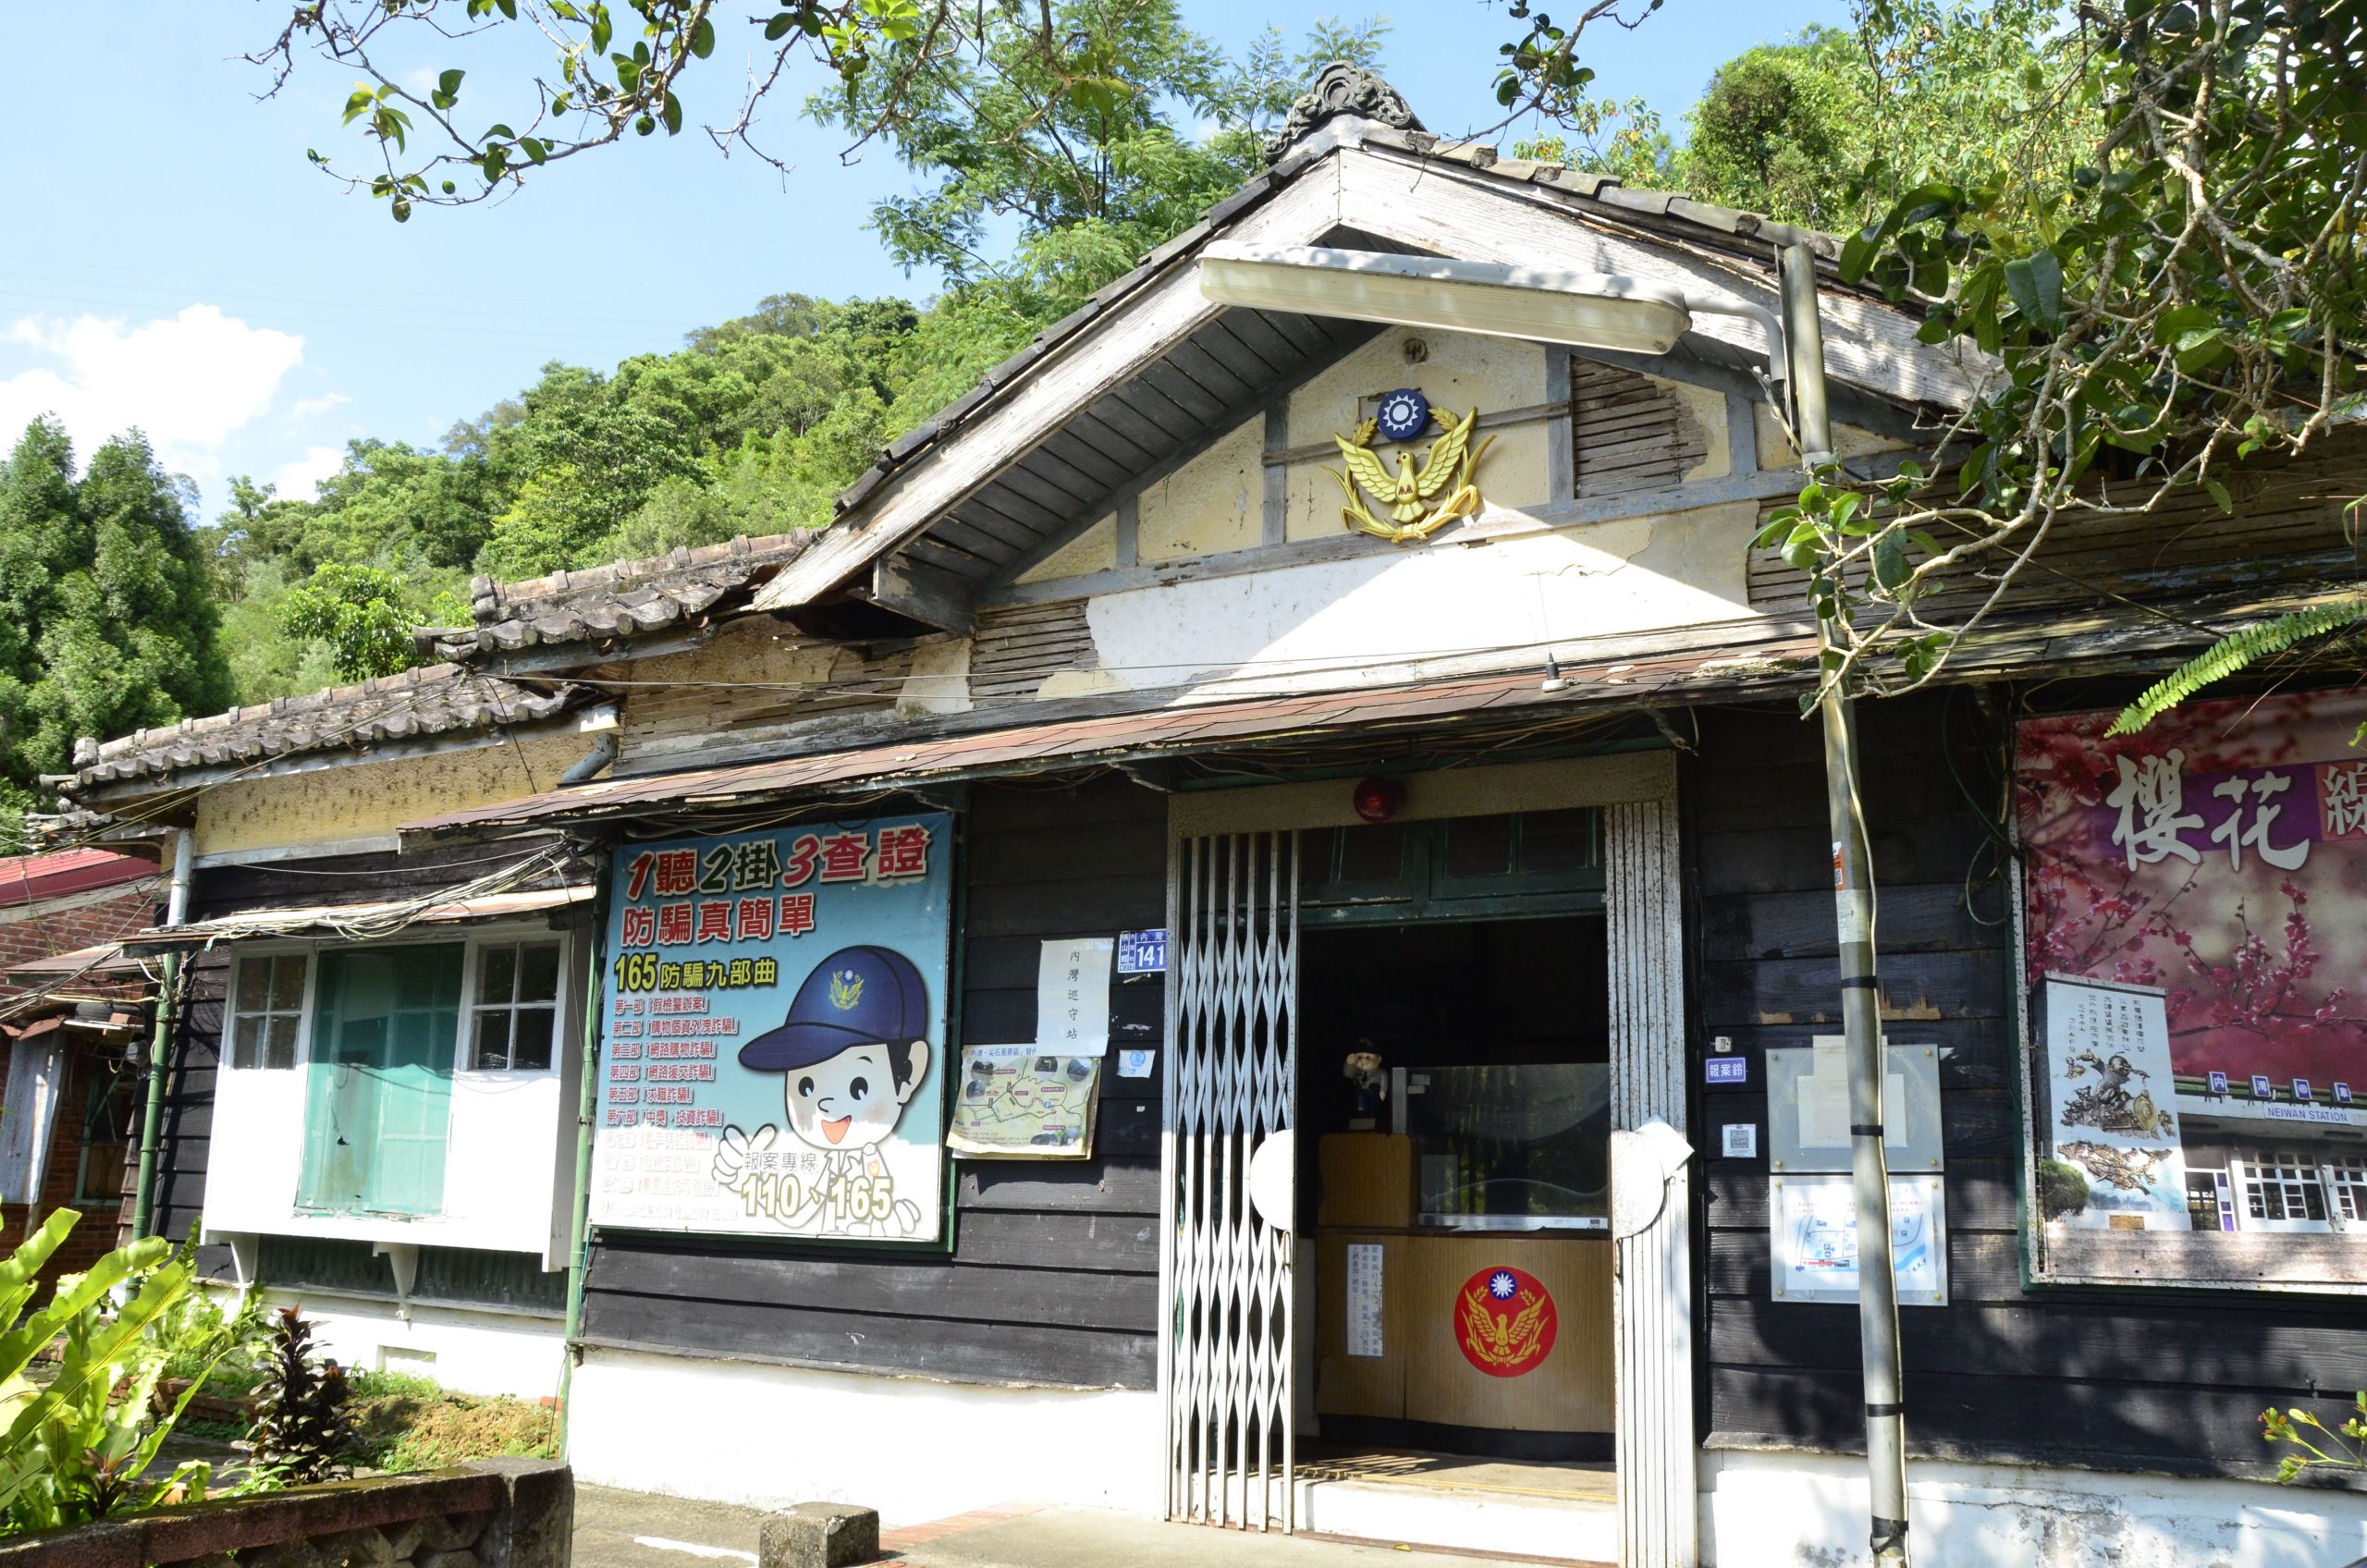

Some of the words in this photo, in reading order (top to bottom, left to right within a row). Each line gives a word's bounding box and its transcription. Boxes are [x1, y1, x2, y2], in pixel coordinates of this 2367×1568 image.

[2106, 748, 2310, 873] 櫻花
[621, 893, 815, 946] 防騙真簡單
[1137, 945, 1164, 967] 141
[1066, 949, 1080, 1039] 內灣巡守站
[1709, 1063, 1743, 1077] 報案鈴
[2267, 1108, 2306, 1120] NEIWAN
[2309, 1110, 2348, 1122] STATION
[744, 1152, 818, 1172] 報案專線
